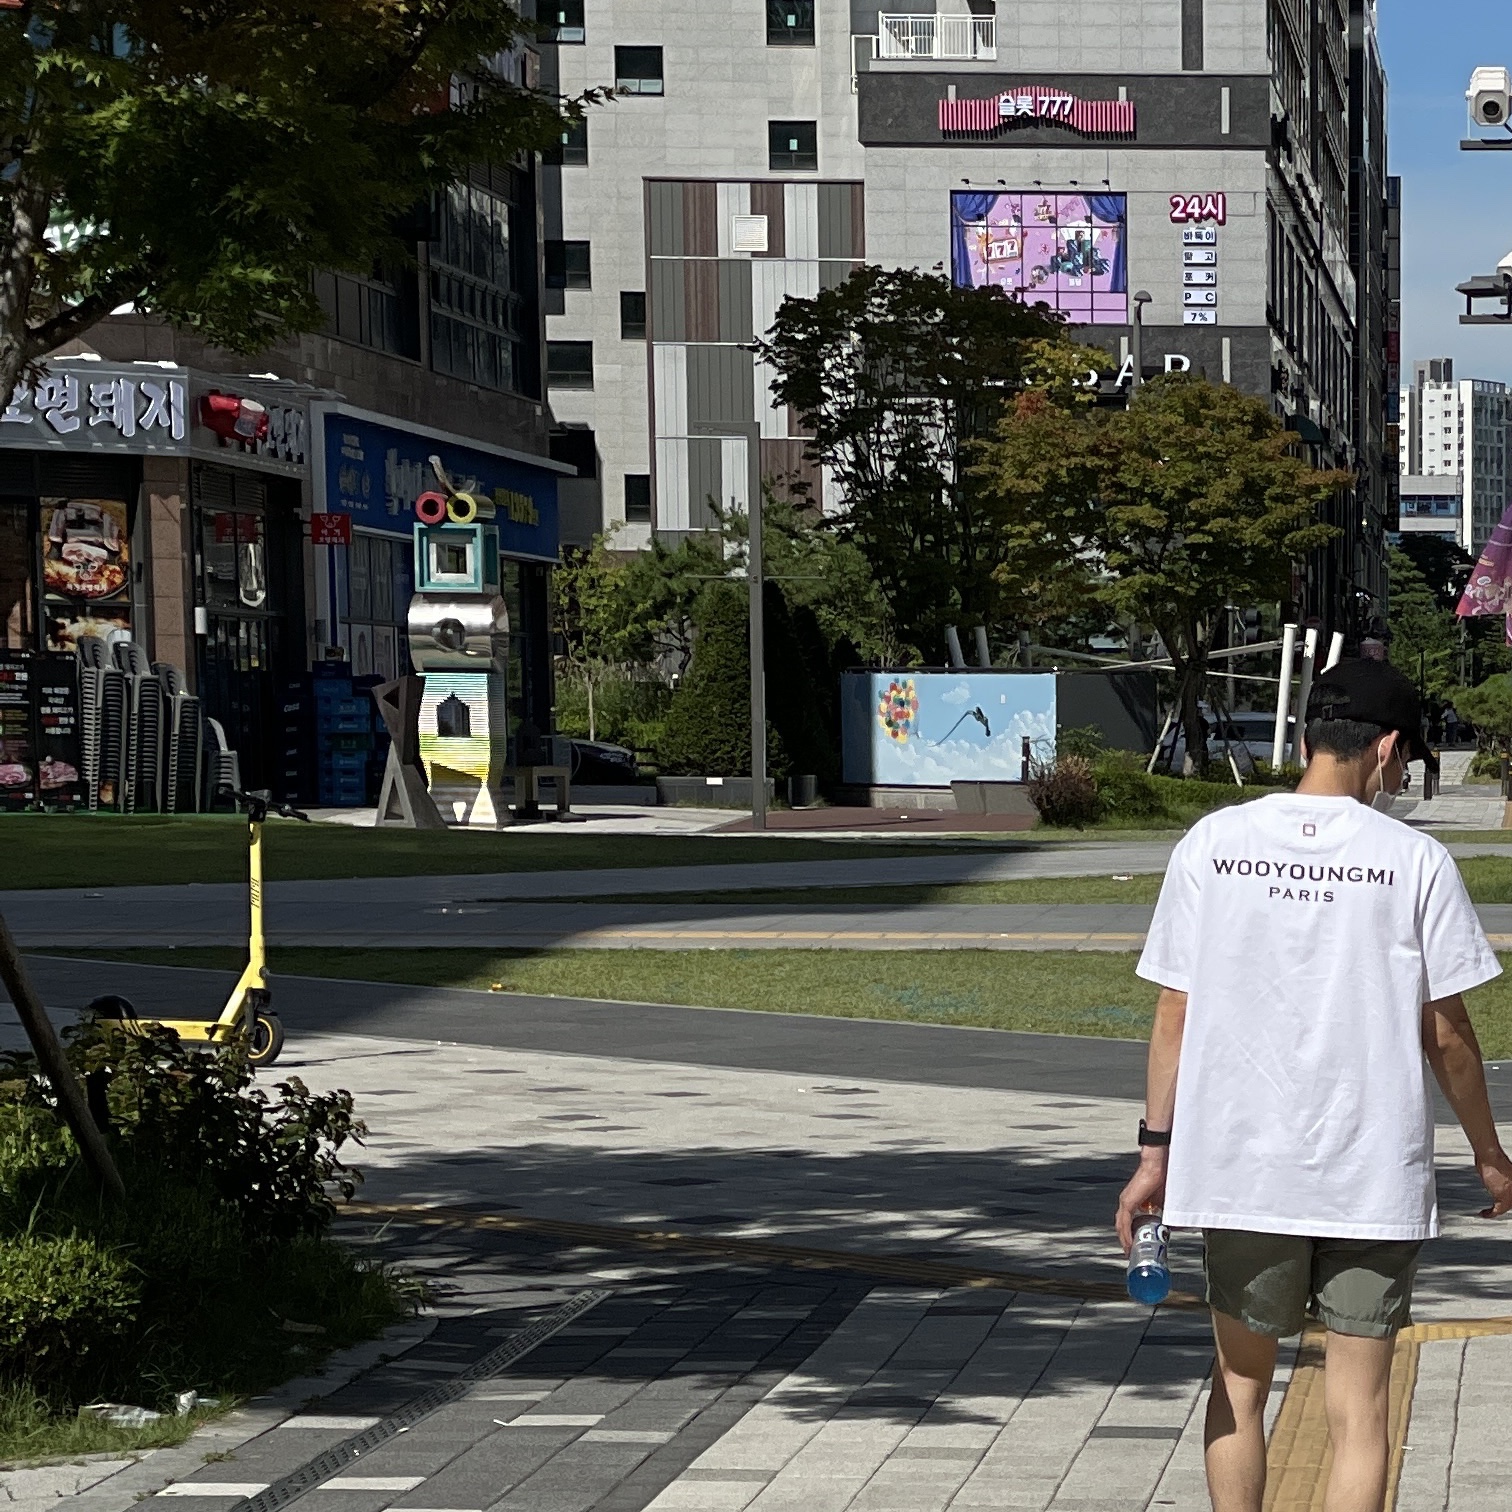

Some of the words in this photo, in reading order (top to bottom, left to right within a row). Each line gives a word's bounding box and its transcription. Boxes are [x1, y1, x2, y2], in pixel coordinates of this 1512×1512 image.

[999, 96, 1035, 117] 슬롯
[1039, 96, 1073, 116] 777
[1170, 192, 1226, 225] 24시
[1190, 312, 1208, 322] 7%
[1212, 858, 1395, 886] WOOYOUNGMI
[1268, 886, 1335, 902] PARIS
